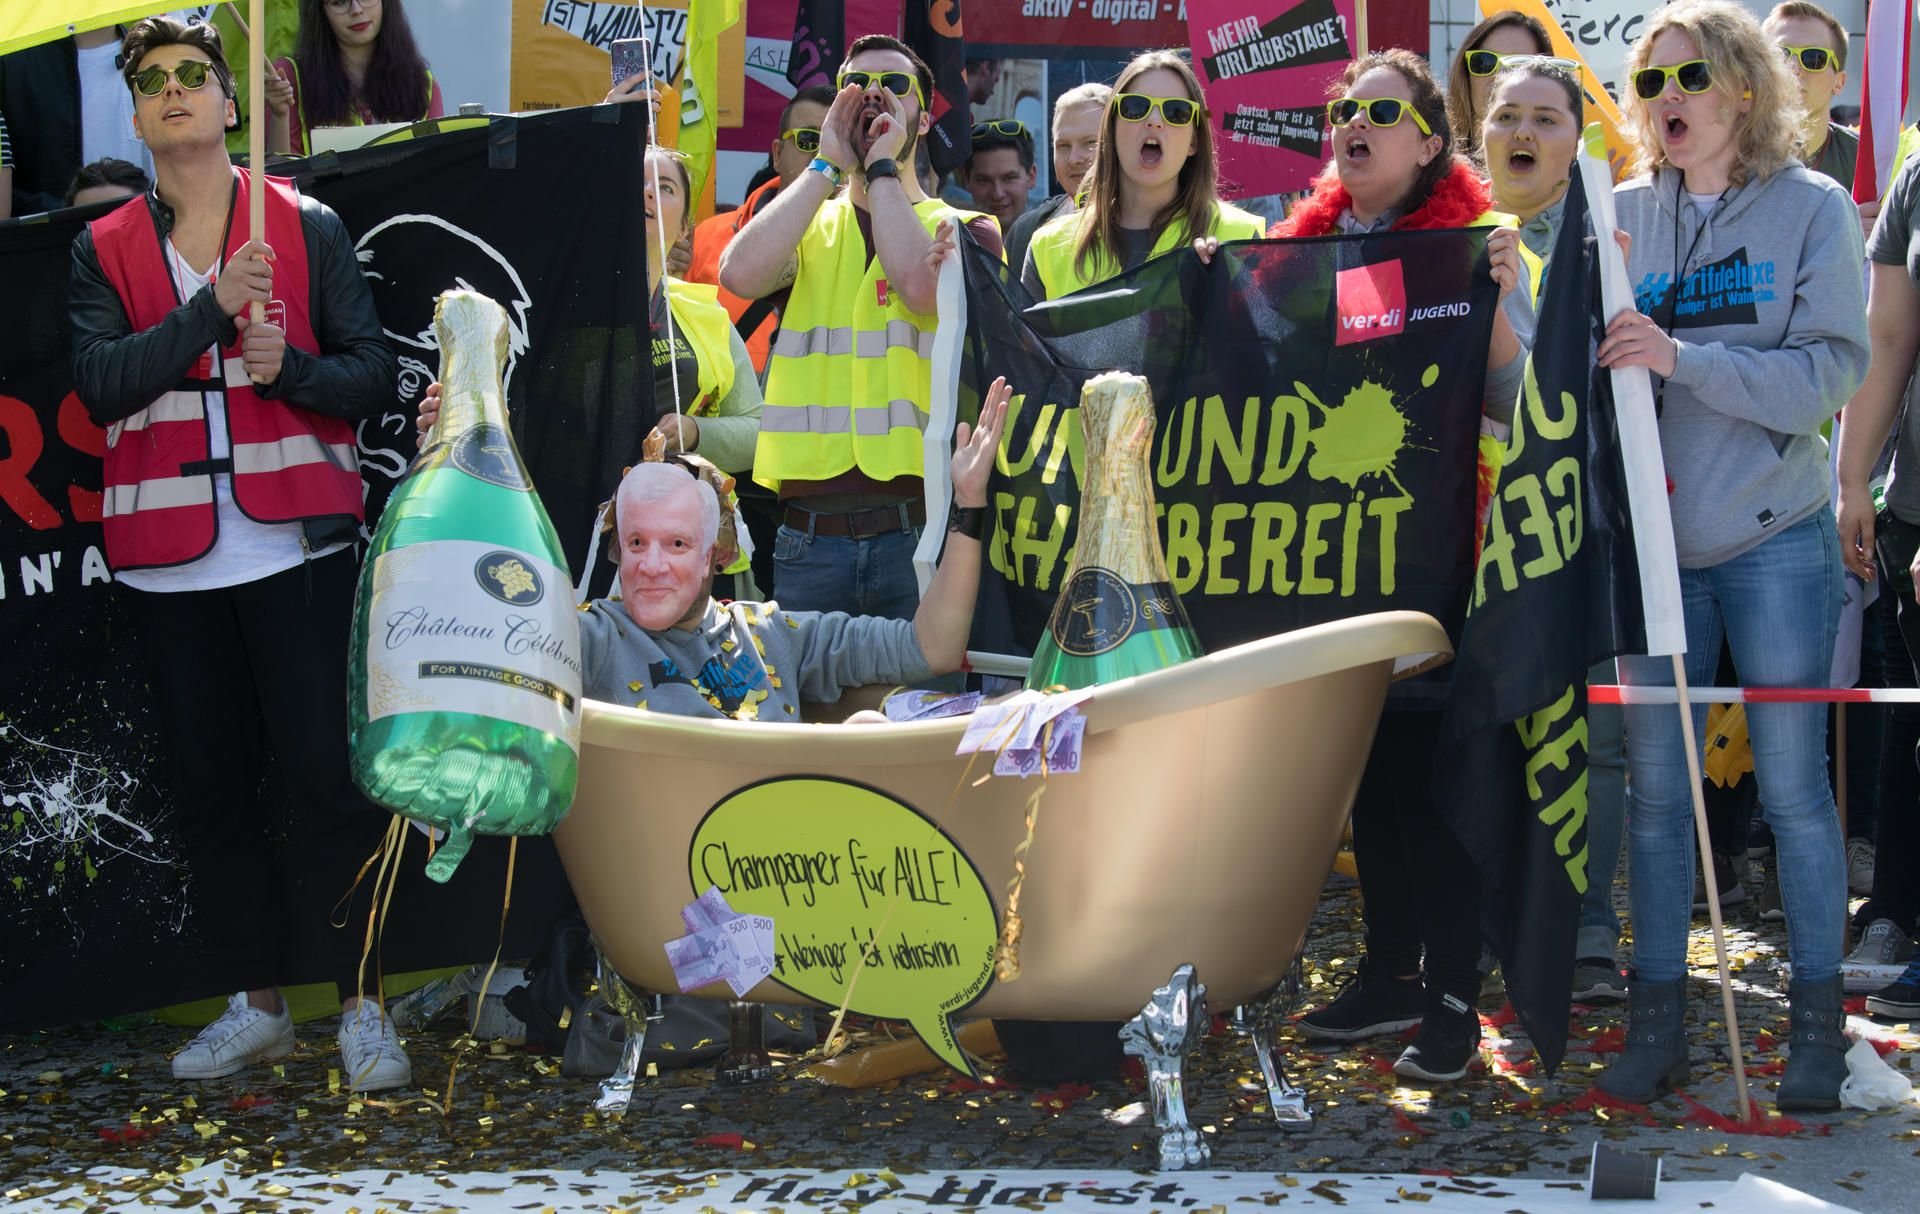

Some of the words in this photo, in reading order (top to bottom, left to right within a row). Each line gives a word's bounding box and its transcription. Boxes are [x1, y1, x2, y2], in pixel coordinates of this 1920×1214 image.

[1207, 15, 1263, 54] MEHR
[1216, 14, 1348, 80] URLAUBSTAGE?
[1233, 117, 1254, 130] jetzt
[1236, 103, 1271, 121] Quatsch,
[1274, 110, 1289, 122] mir
[1292, 111, 1303, 124] ist
[1305, 113, 1314, 127] ja
[1232, 130, 1246, 143] der
[1248, 132, 1281, 148] Freizeit!
[1341, 308, 1401, 330] ver.di
[1409, 302, 1471, 322] JUGEND
[1710, 295, 1724, 309] ist
[1157, 394, 1310, 488] UND
[385, 605, 496, 650] Château
[430, 664, 456, 675] FOR
[460, 665, 512, 684] VINTAGE
[513, 674, 545, 693] GOOD
[701, 841, 842, 908] Champagner
[729, 919, 748, 934] 500
[753, 918, 772, 930] 500
[937, 944, 994, 1051] www.verdi-jugend.de
